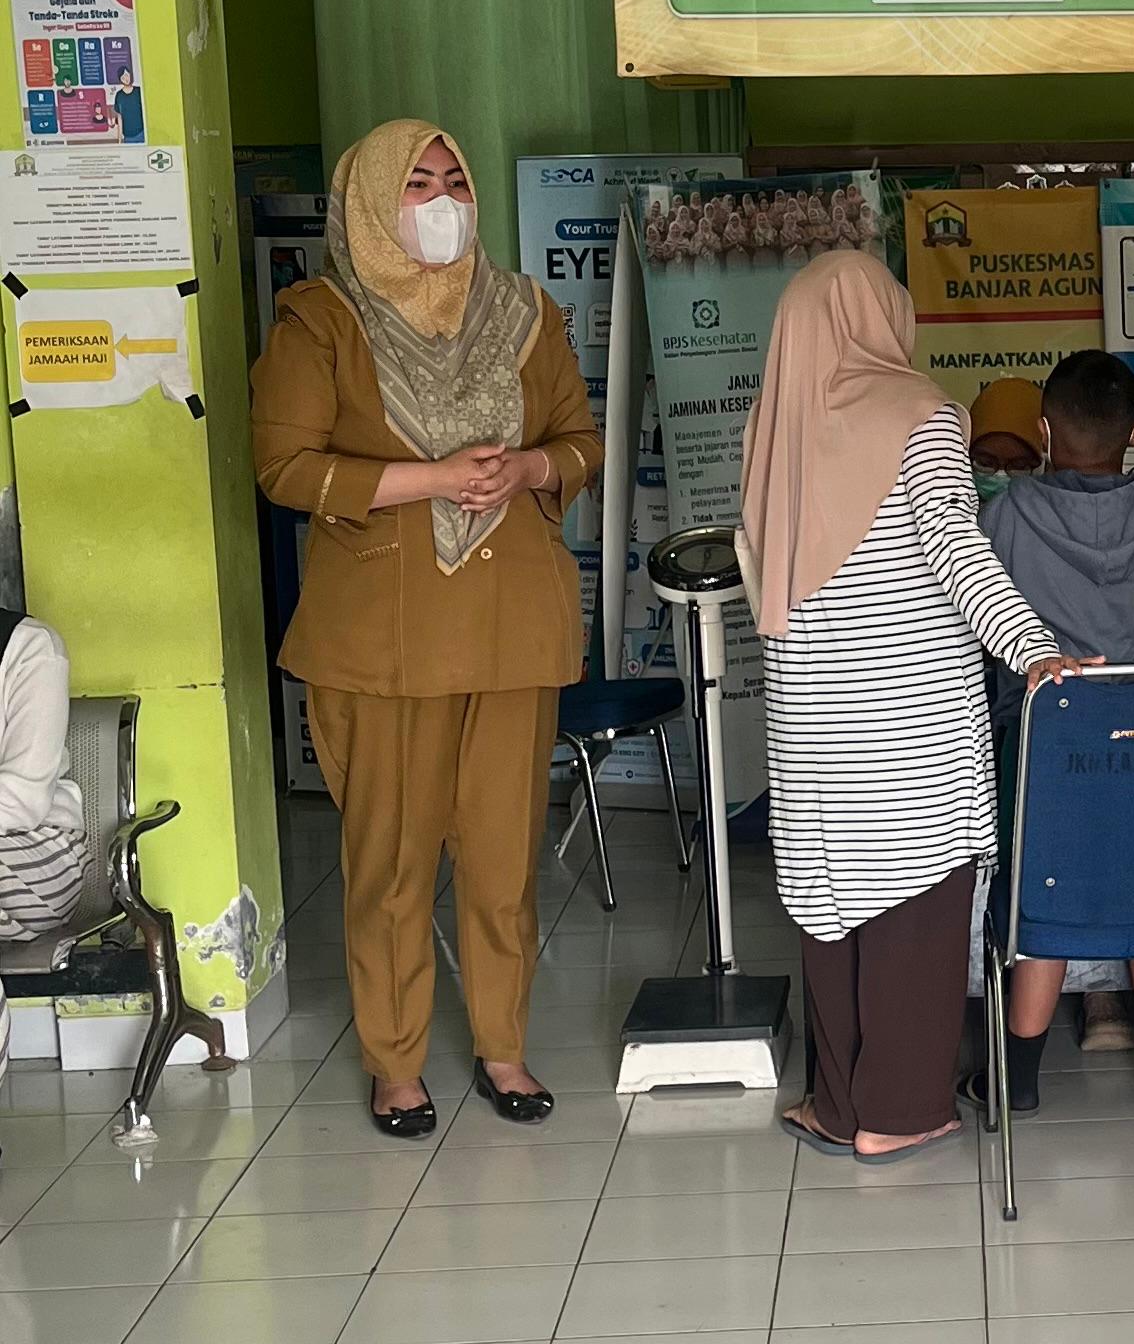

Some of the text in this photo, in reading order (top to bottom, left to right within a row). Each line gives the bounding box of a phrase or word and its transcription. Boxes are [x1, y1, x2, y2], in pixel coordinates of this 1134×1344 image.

[28, 8, 119, 21] Tanda-Tanda Stroke
[563, 223, 592, 235] Your
[546, 248, 611, 280] EYE
[969, 252, 1095, 274] PUSKESMAS
[946, 276, 1103, 299] BANJAR AGUN
[25, 335, 109, 347] PEMERIKSAAN
[663, 332, 757, 350] BPJS Kesehatan
[28, 353, 108, 365] JAMAAH HAJI
[929, 350, 1053, 369] MANFAATKAN
[727, 374, 760, 391] JANJI
[668, 396, 753, 418] JAMINAN KESE
[721, 689, 751, 702] Kepala
